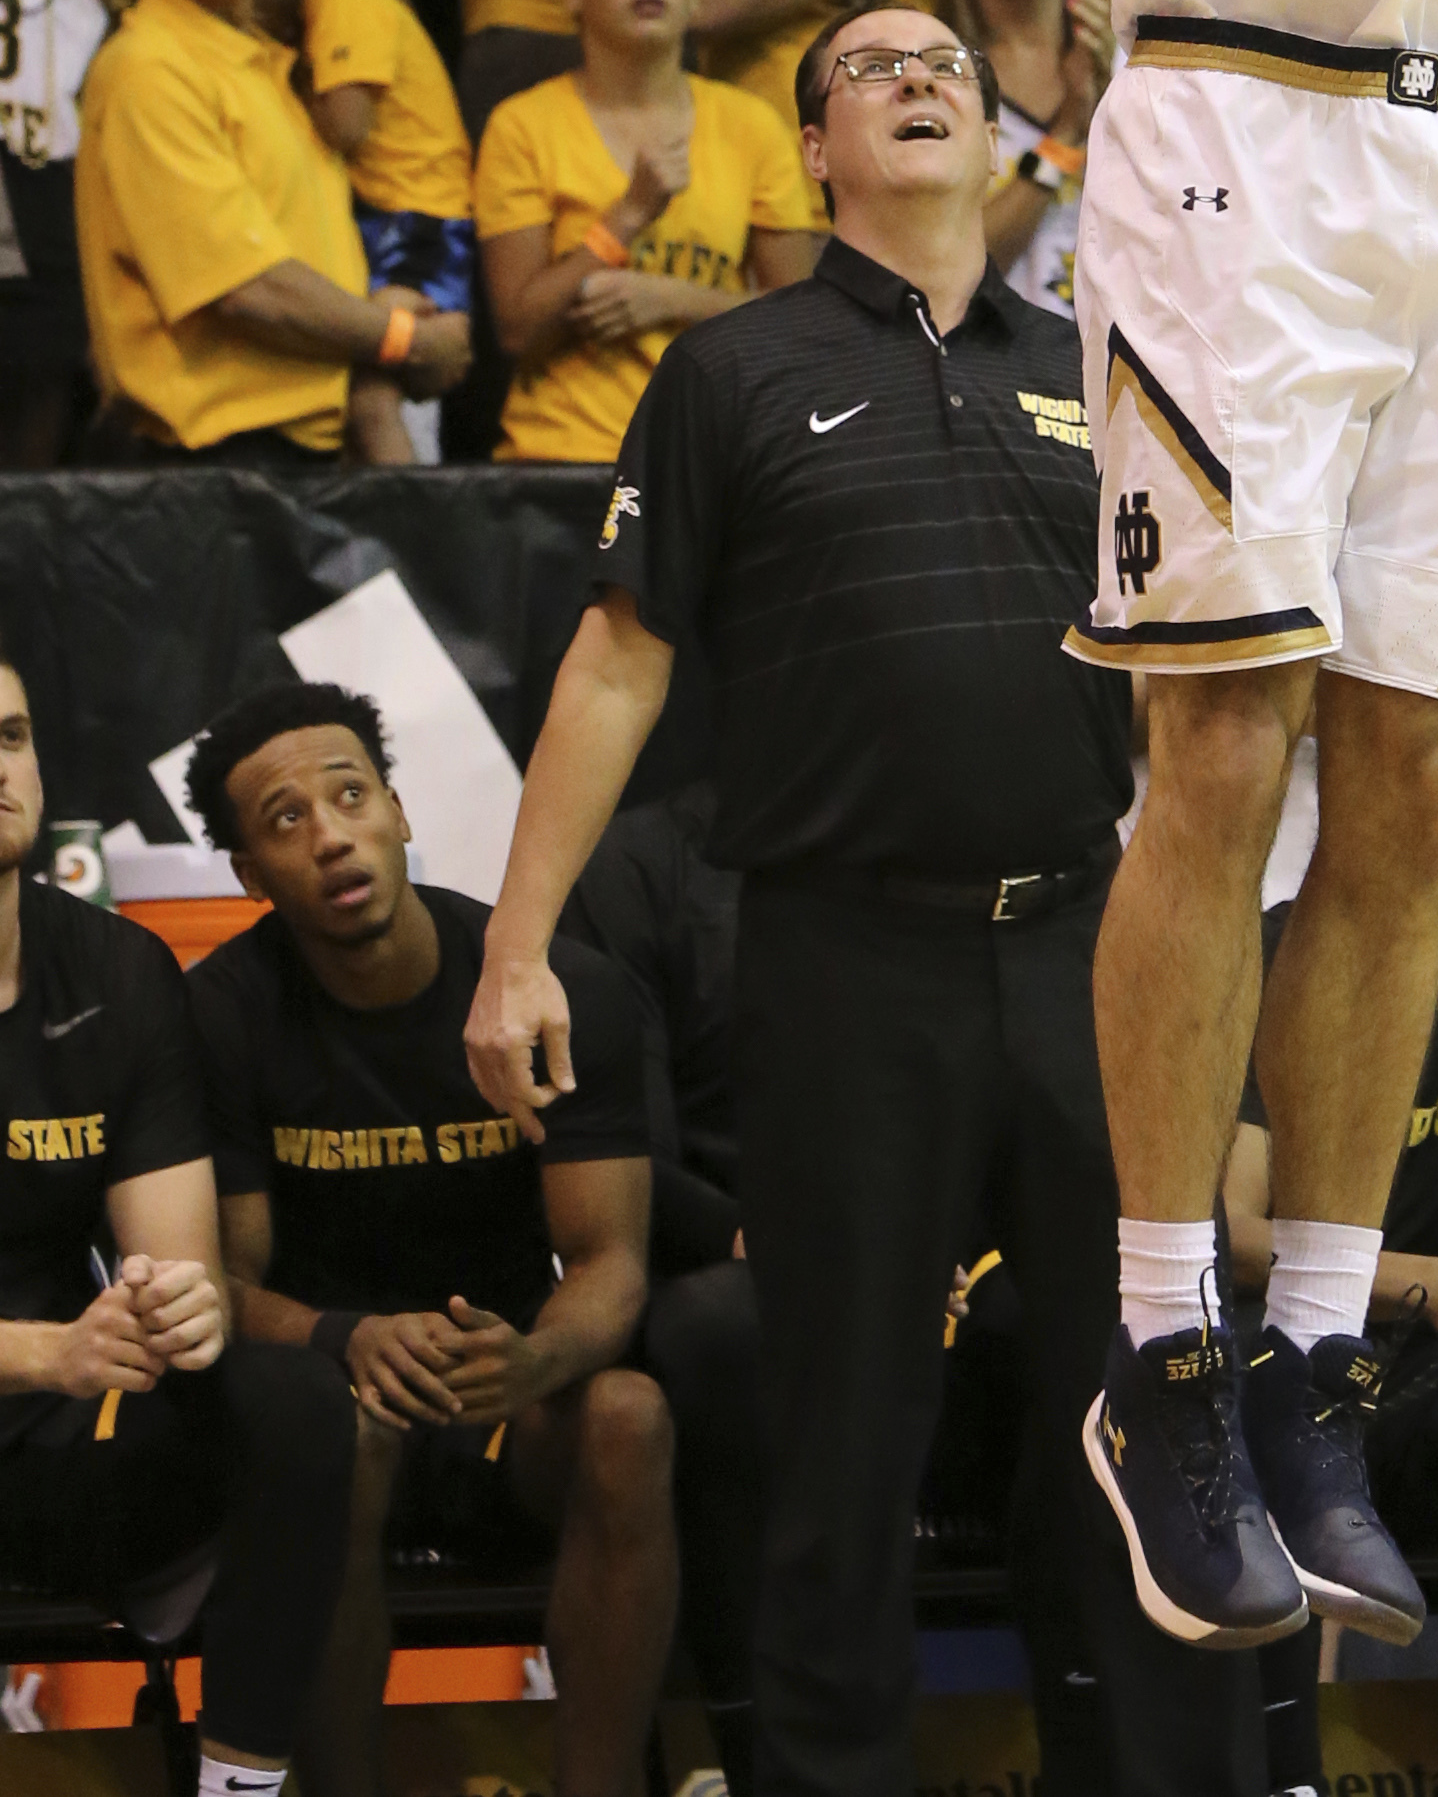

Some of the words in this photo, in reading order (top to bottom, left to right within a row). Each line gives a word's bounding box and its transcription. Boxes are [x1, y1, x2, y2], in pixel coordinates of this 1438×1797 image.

[1034, 415, 1092, 450] STATE
[7, 1112, 106, 1162] STATE
[273, 1126, 429, 1171] WICHITA
[436, 1117, 519, 1163] STAT
